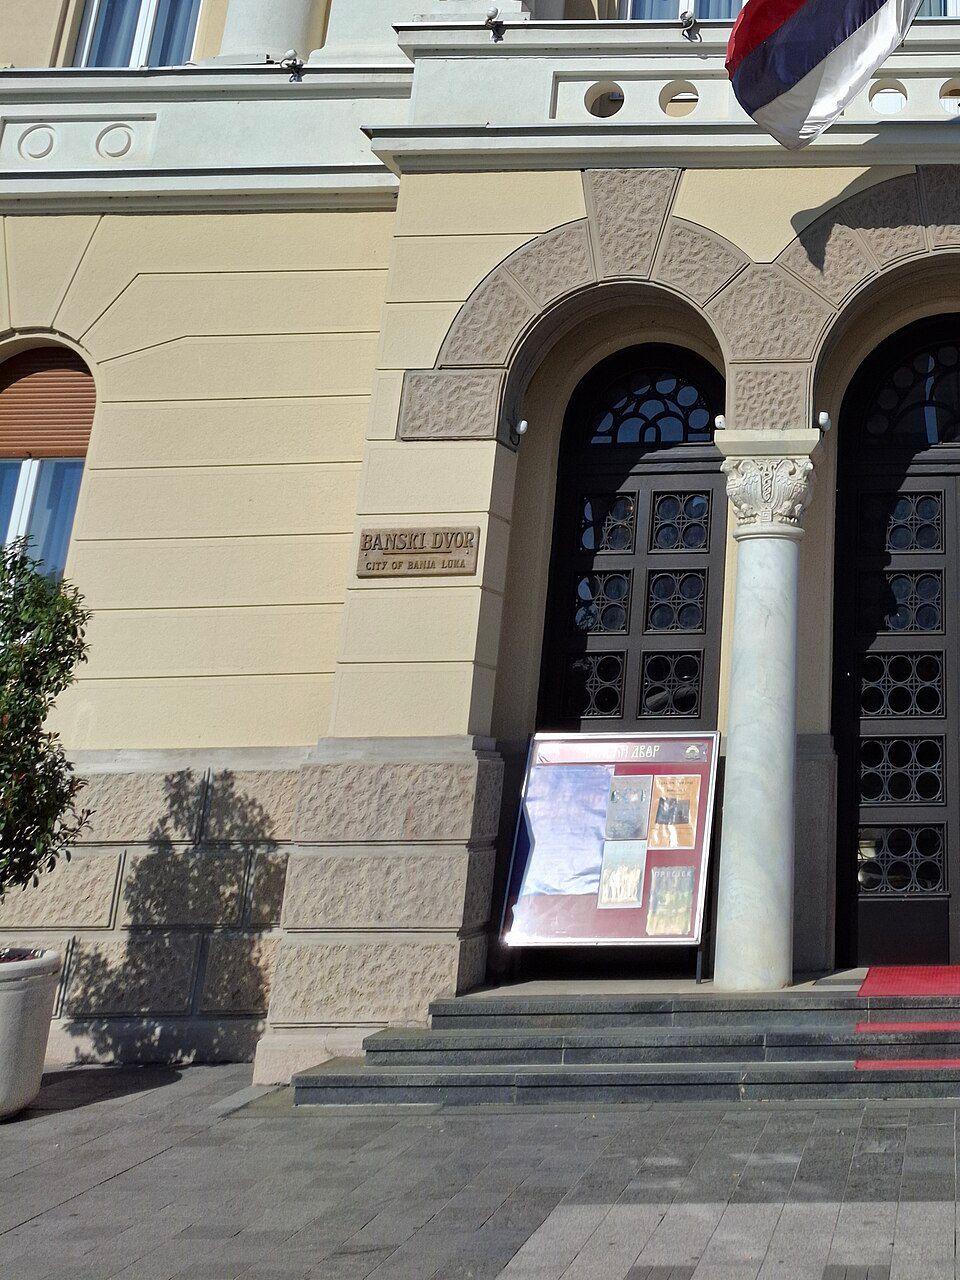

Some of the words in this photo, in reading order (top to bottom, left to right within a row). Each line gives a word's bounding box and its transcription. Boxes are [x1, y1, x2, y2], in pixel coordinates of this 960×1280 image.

[361, 532, 427, 551] BANSKI
[430, 531, 475, 549] DVOR
[365, 561, 388, 571] CITY
[391, 561, 404, 570] OF
[441, 559, 466, 569] LUKA
